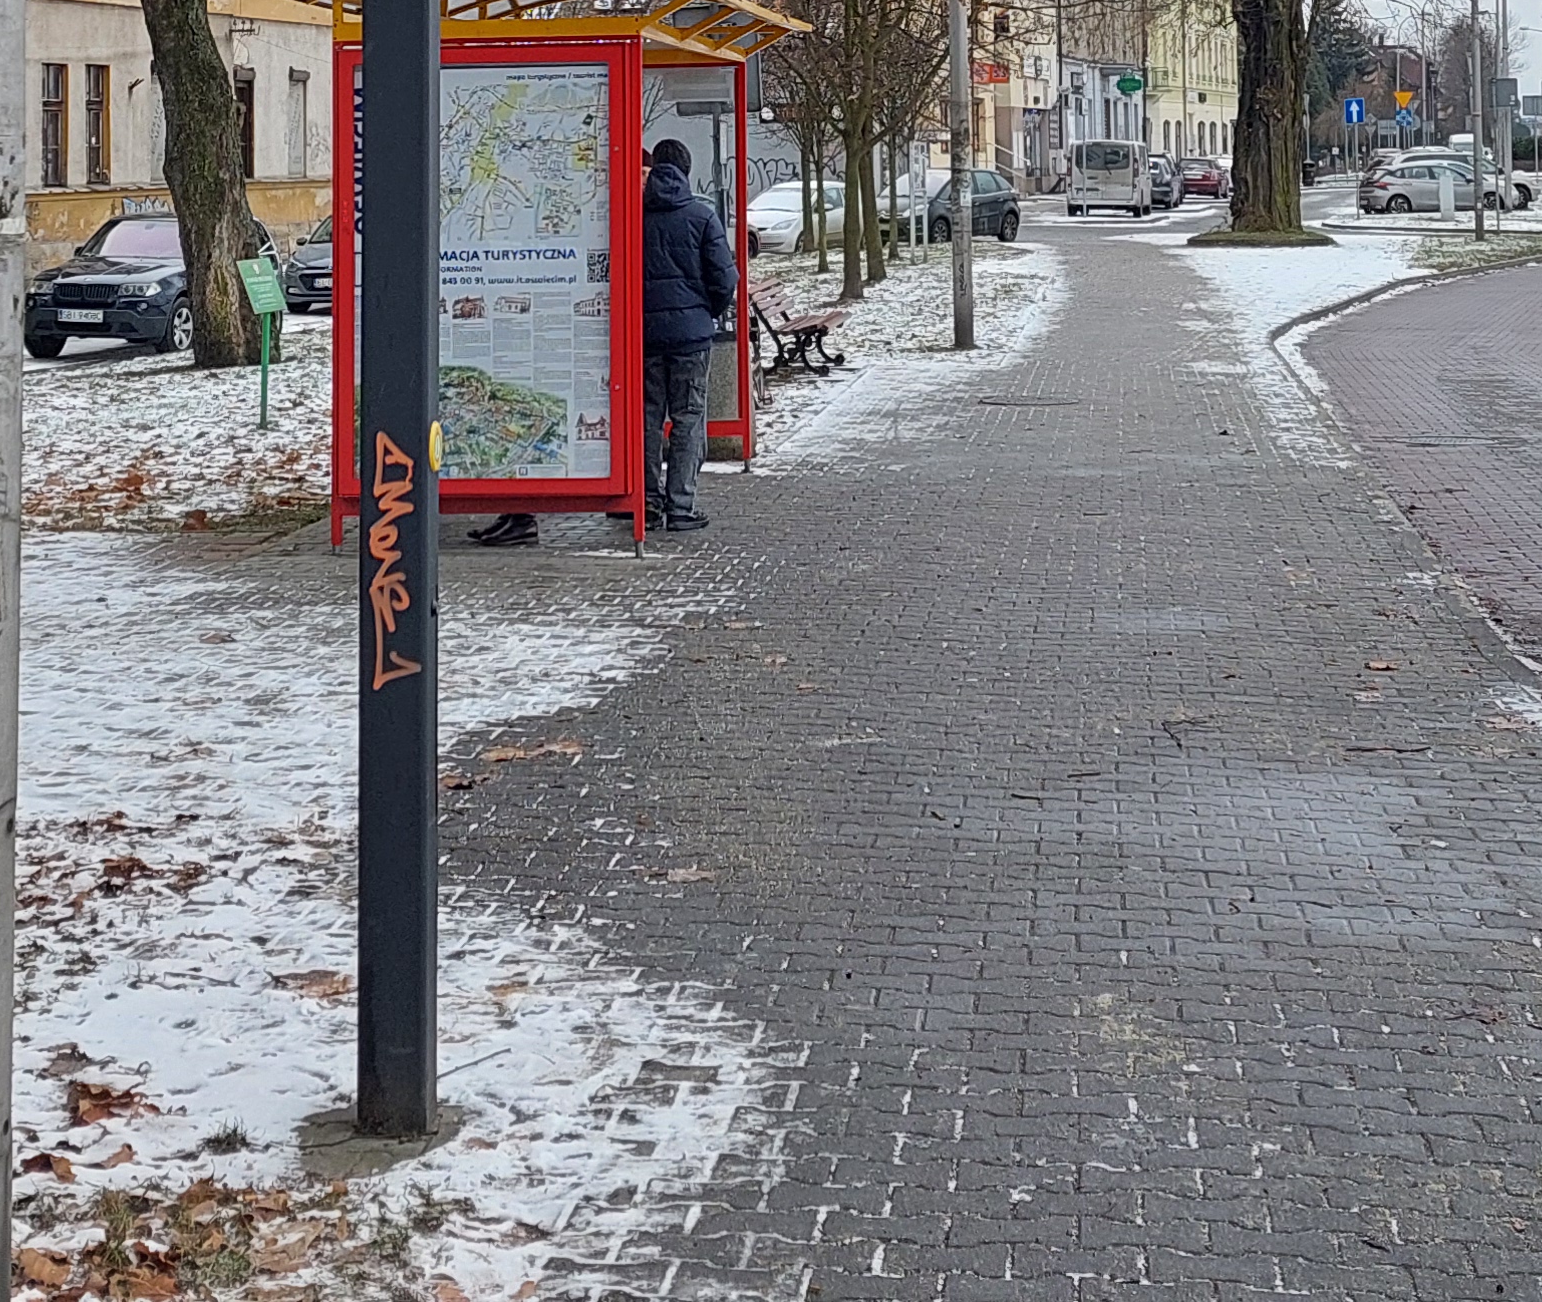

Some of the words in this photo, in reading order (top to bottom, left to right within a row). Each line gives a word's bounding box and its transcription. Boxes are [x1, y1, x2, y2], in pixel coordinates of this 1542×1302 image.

[439, 250, 481, 263] MACJA
[482, 248, 578, 261] TURYSTYCZNA
[440, 265, 483, 273] ORMATION
